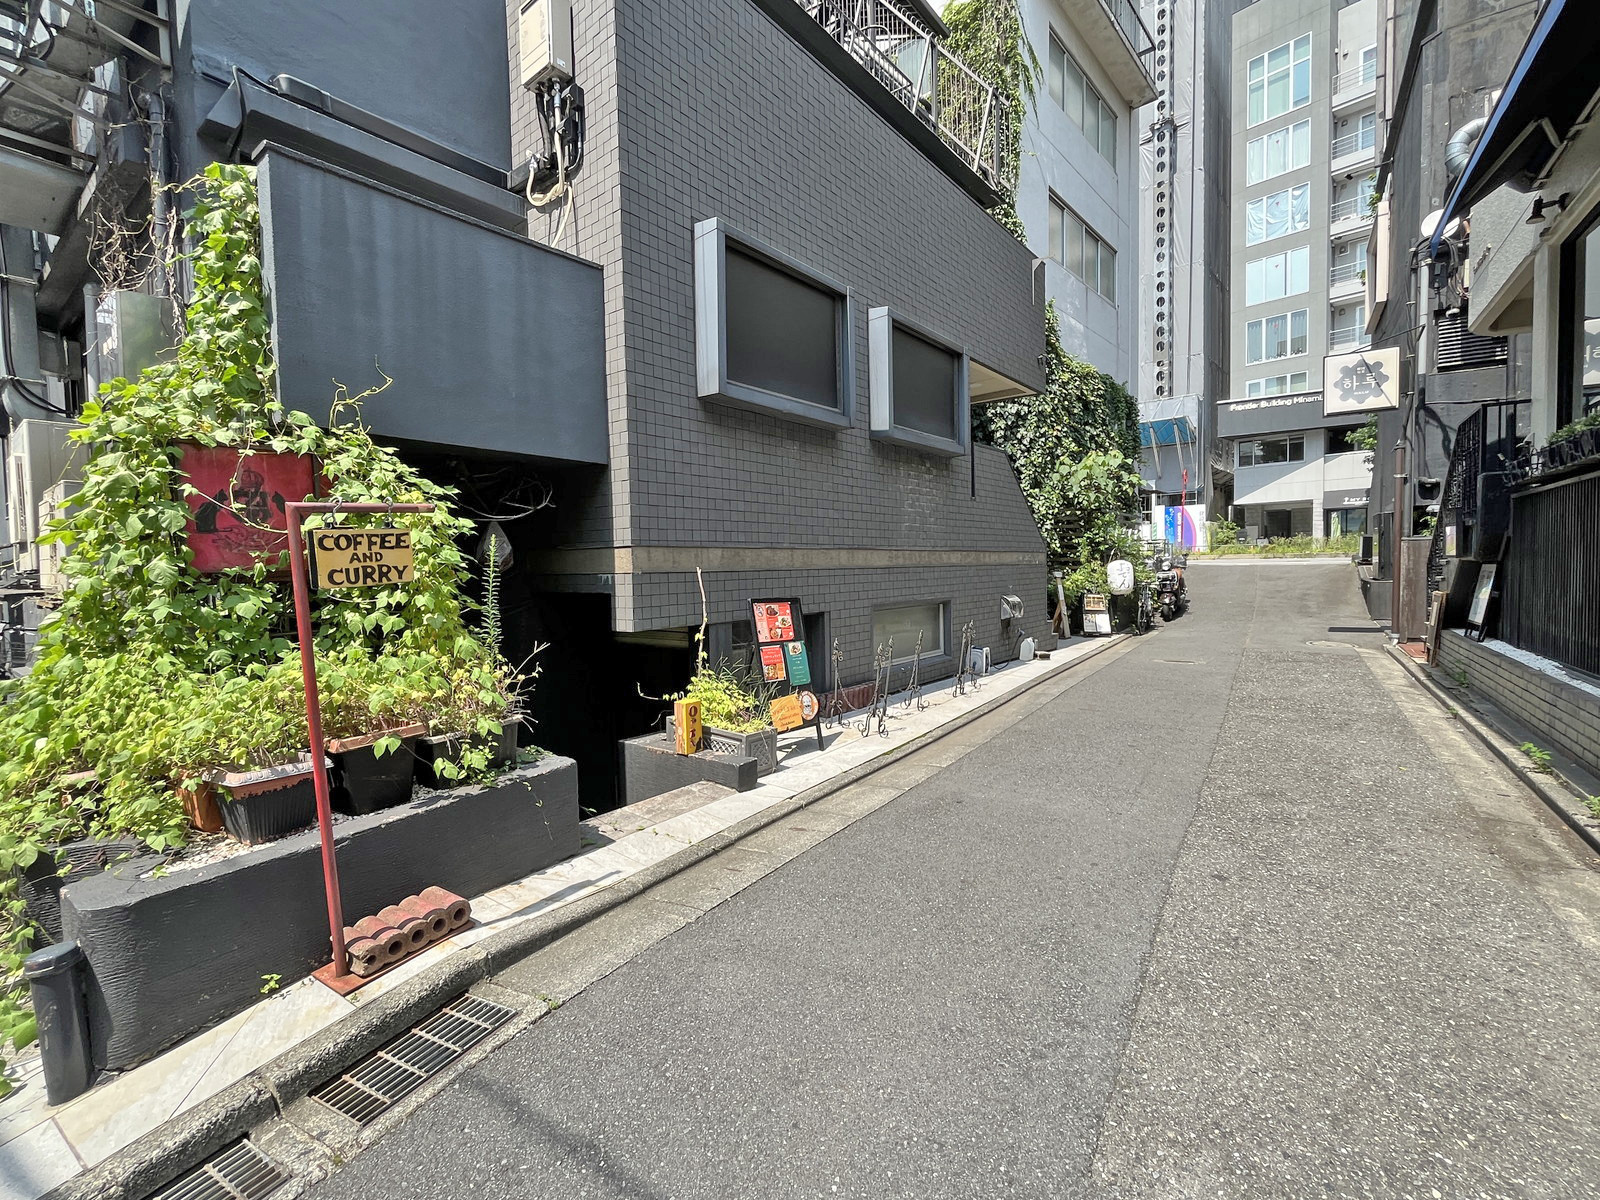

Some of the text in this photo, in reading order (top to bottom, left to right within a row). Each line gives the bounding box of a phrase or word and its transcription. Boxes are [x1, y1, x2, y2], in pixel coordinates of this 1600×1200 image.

[1229, 403, 1259, 412] Frontier
[1260, 398, 1292, 408] Building
[317, 532, 410, 551] COFFEE
[349, 551, 383, 564] AND
[327, 564, 409, 585] CURRY
